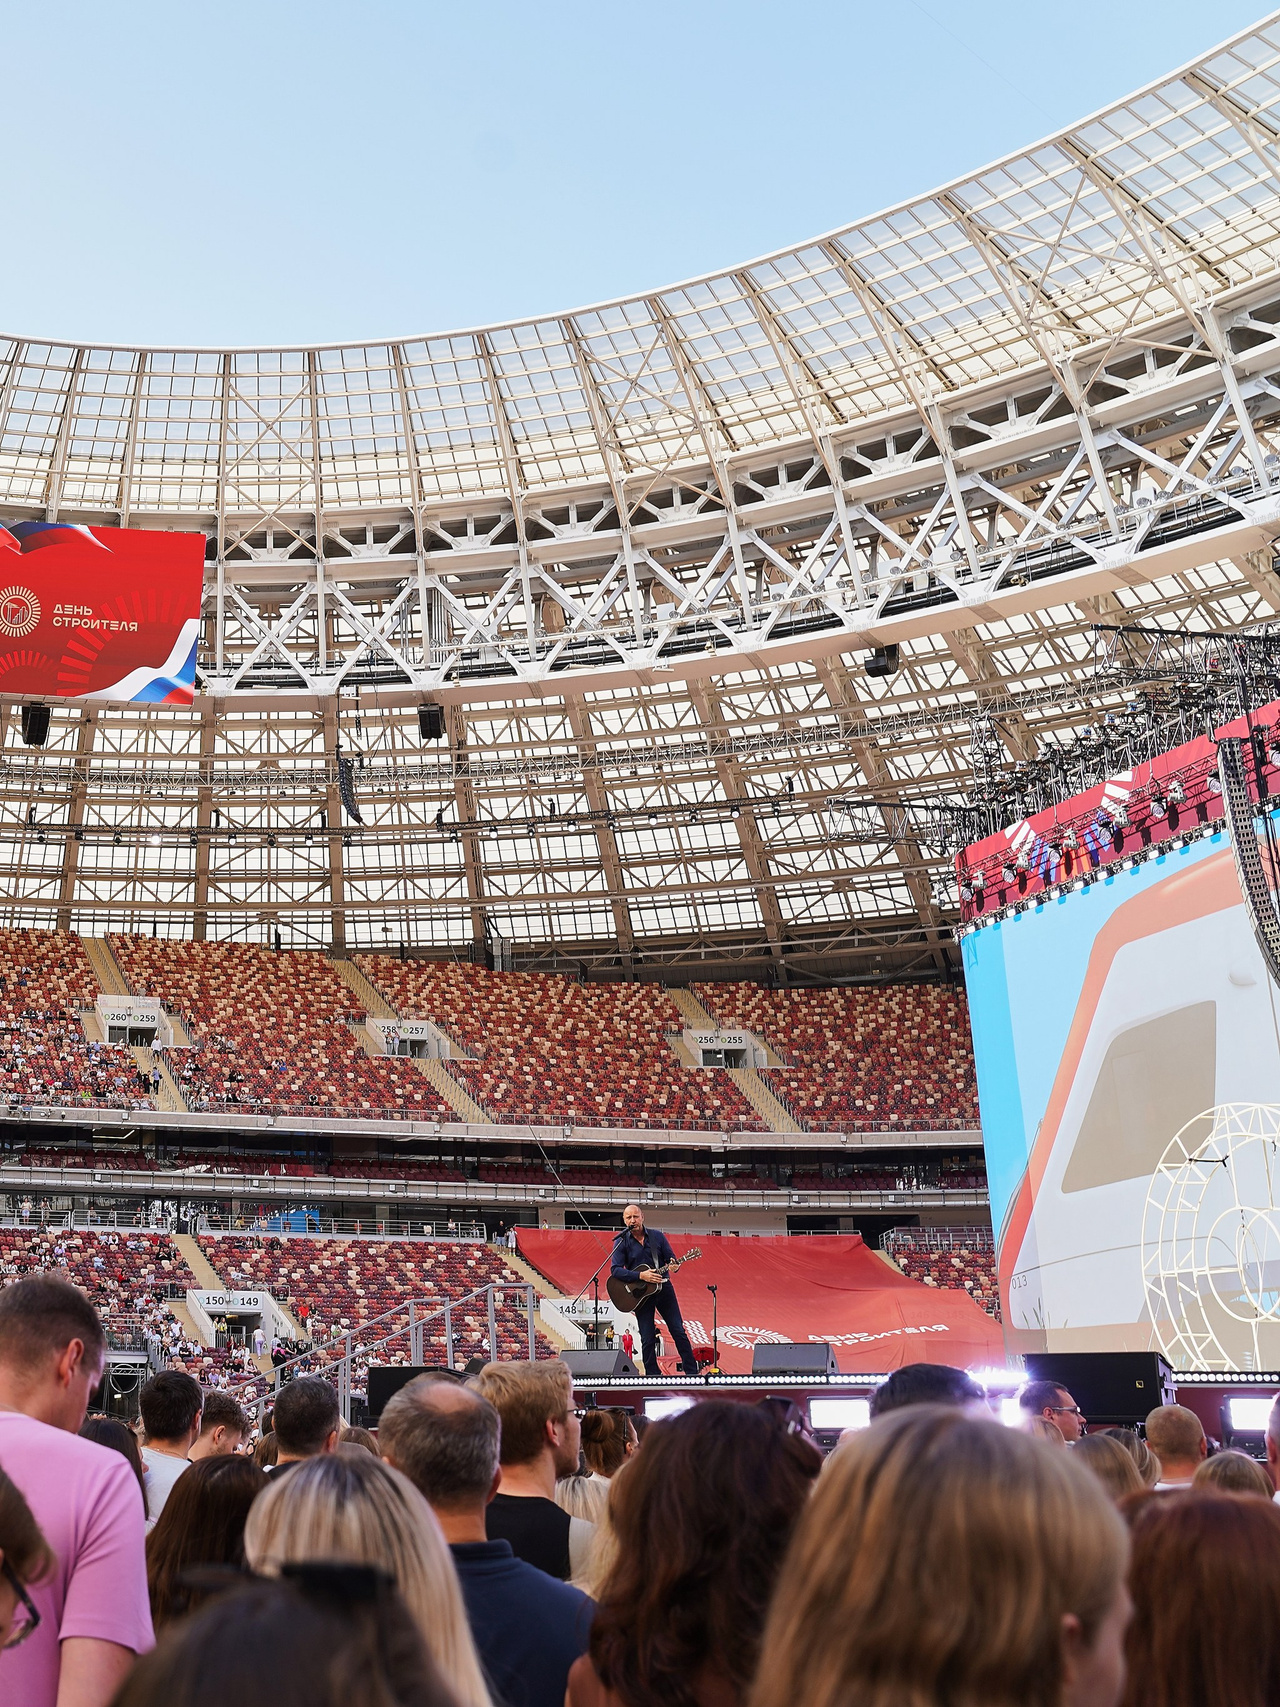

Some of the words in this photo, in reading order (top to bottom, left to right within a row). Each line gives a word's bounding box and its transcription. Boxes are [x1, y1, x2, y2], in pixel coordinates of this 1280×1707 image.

[52, 603, 93, 616] ДЕНЬ
[52, 616, 138, 632] СТРОИТЕЛЯ
[110, 1013, 127, 1021] 260
[140, 1014, 156, 1022] 259
[381, 1025, 397, 1033] 258
[698, 1036, 714, 1044] 256
[727, 1036, 743, 1044] 255
[1011, 1274, 1028, 1290] 013
[205, 1296, 224, 1305] 150
[240, 1297, 259, 1306] 149
[559, 1305, 577, 1314] 148
[807, 1332, 869, 1341] ДЕНЬ
[816, 1324, 950, 1347] ТРОИТЕЛЯ
